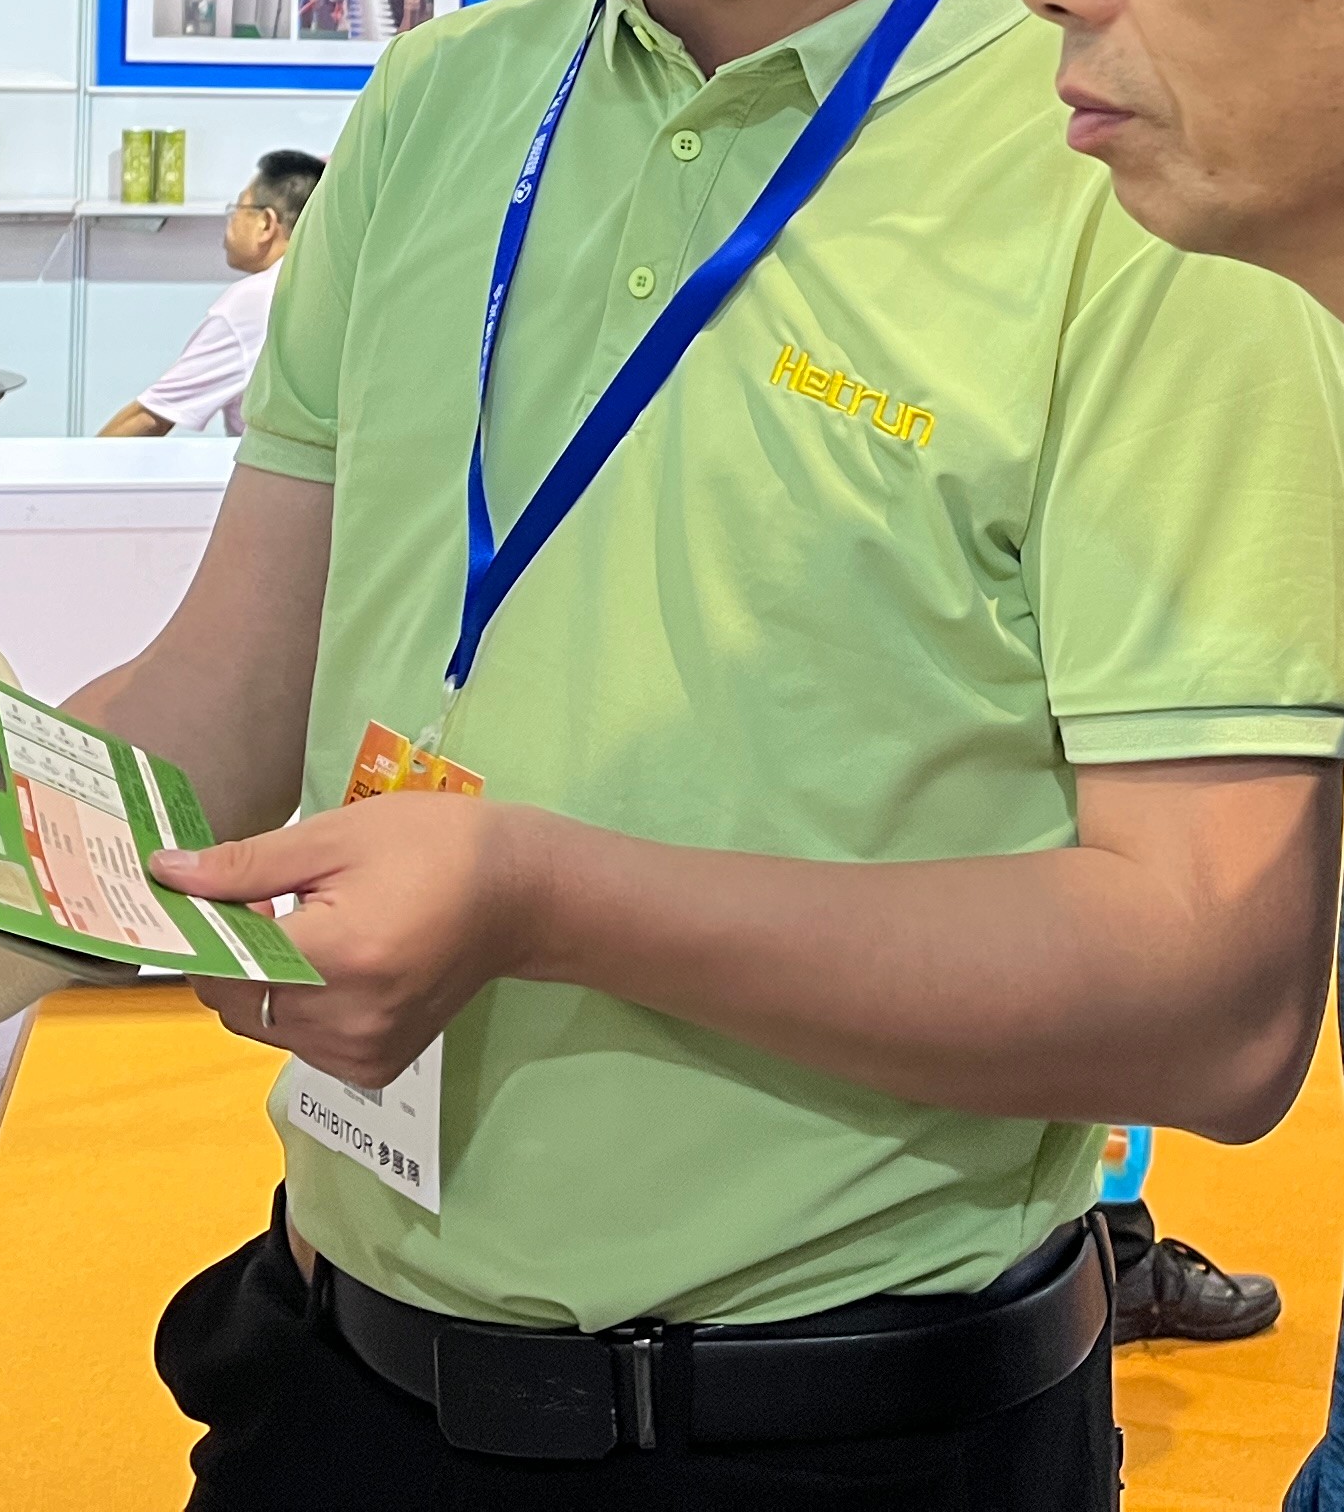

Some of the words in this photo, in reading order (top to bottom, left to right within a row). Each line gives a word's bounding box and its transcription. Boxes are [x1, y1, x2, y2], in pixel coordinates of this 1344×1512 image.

[770, 345, 936, 448] Hetrun
[299, 1092, 374, 1159] EXHIBITOR
[377, 1141, 420, 1188] 参展商
